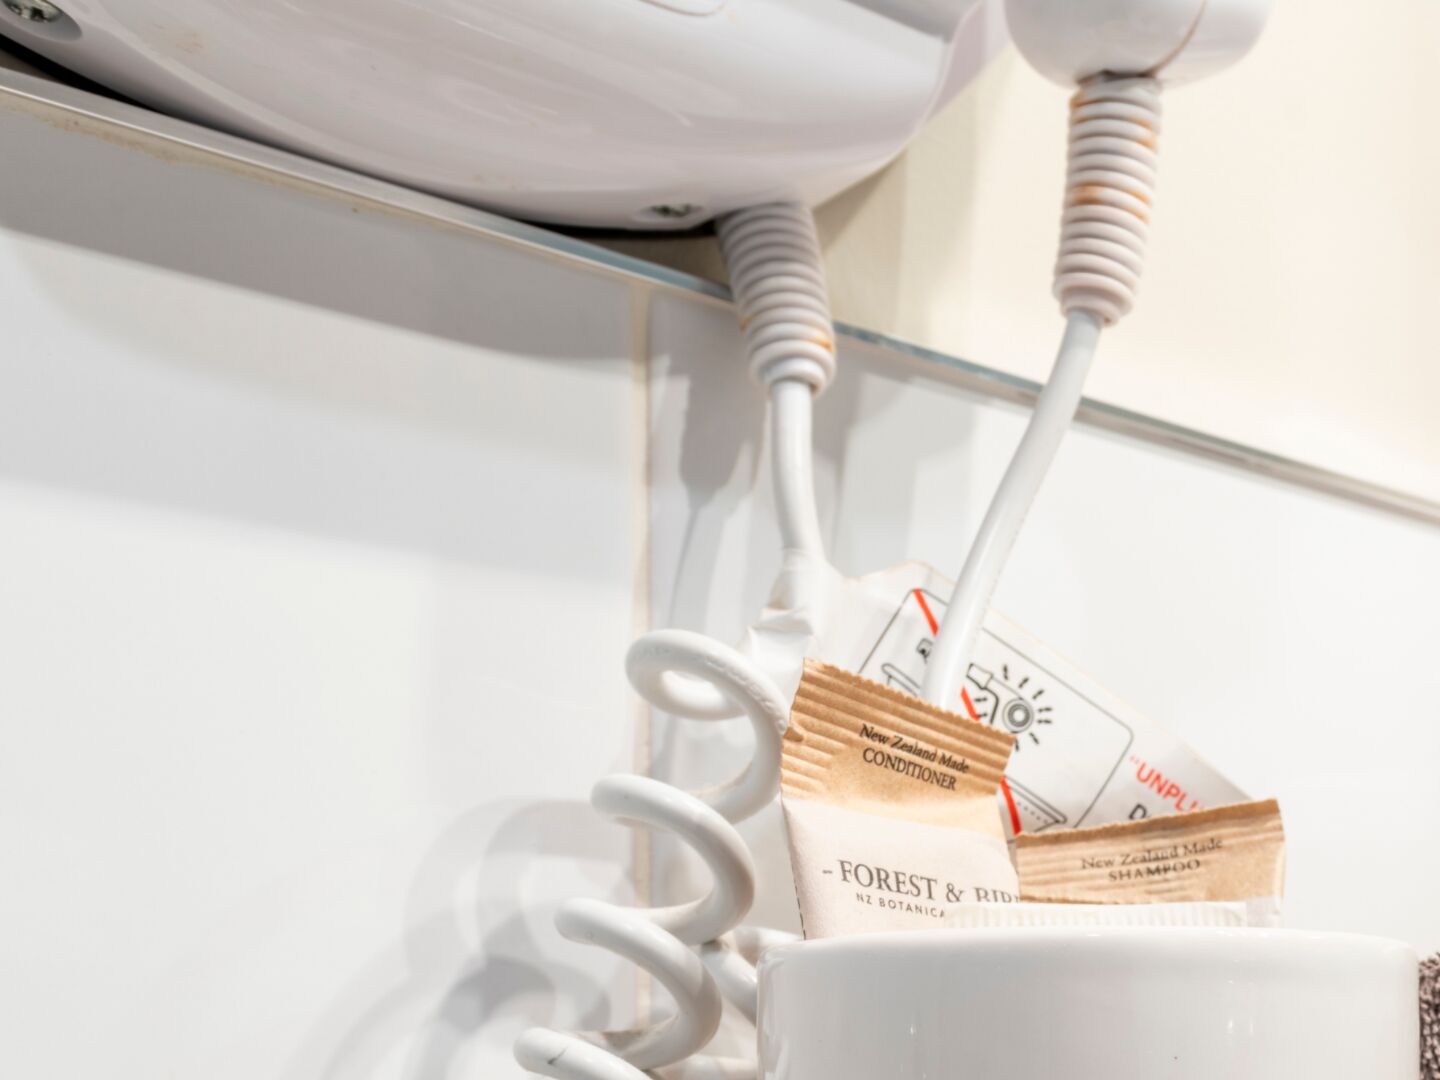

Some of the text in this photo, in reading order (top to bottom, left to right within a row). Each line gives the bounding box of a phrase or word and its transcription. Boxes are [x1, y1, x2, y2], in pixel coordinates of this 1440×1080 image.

[859, 723, 970, 774] New Zealand Made
[862, 747, 958, 791] CONDITIONER
[1081, 838, 1223, 870] New Zealand Made
[1108, 859, 1201, 881] SHAMPOO
[837, 859, 938, 900] FOREST
[945, 882, 965, 904] &
[856, 892, 873, 906] NZ
